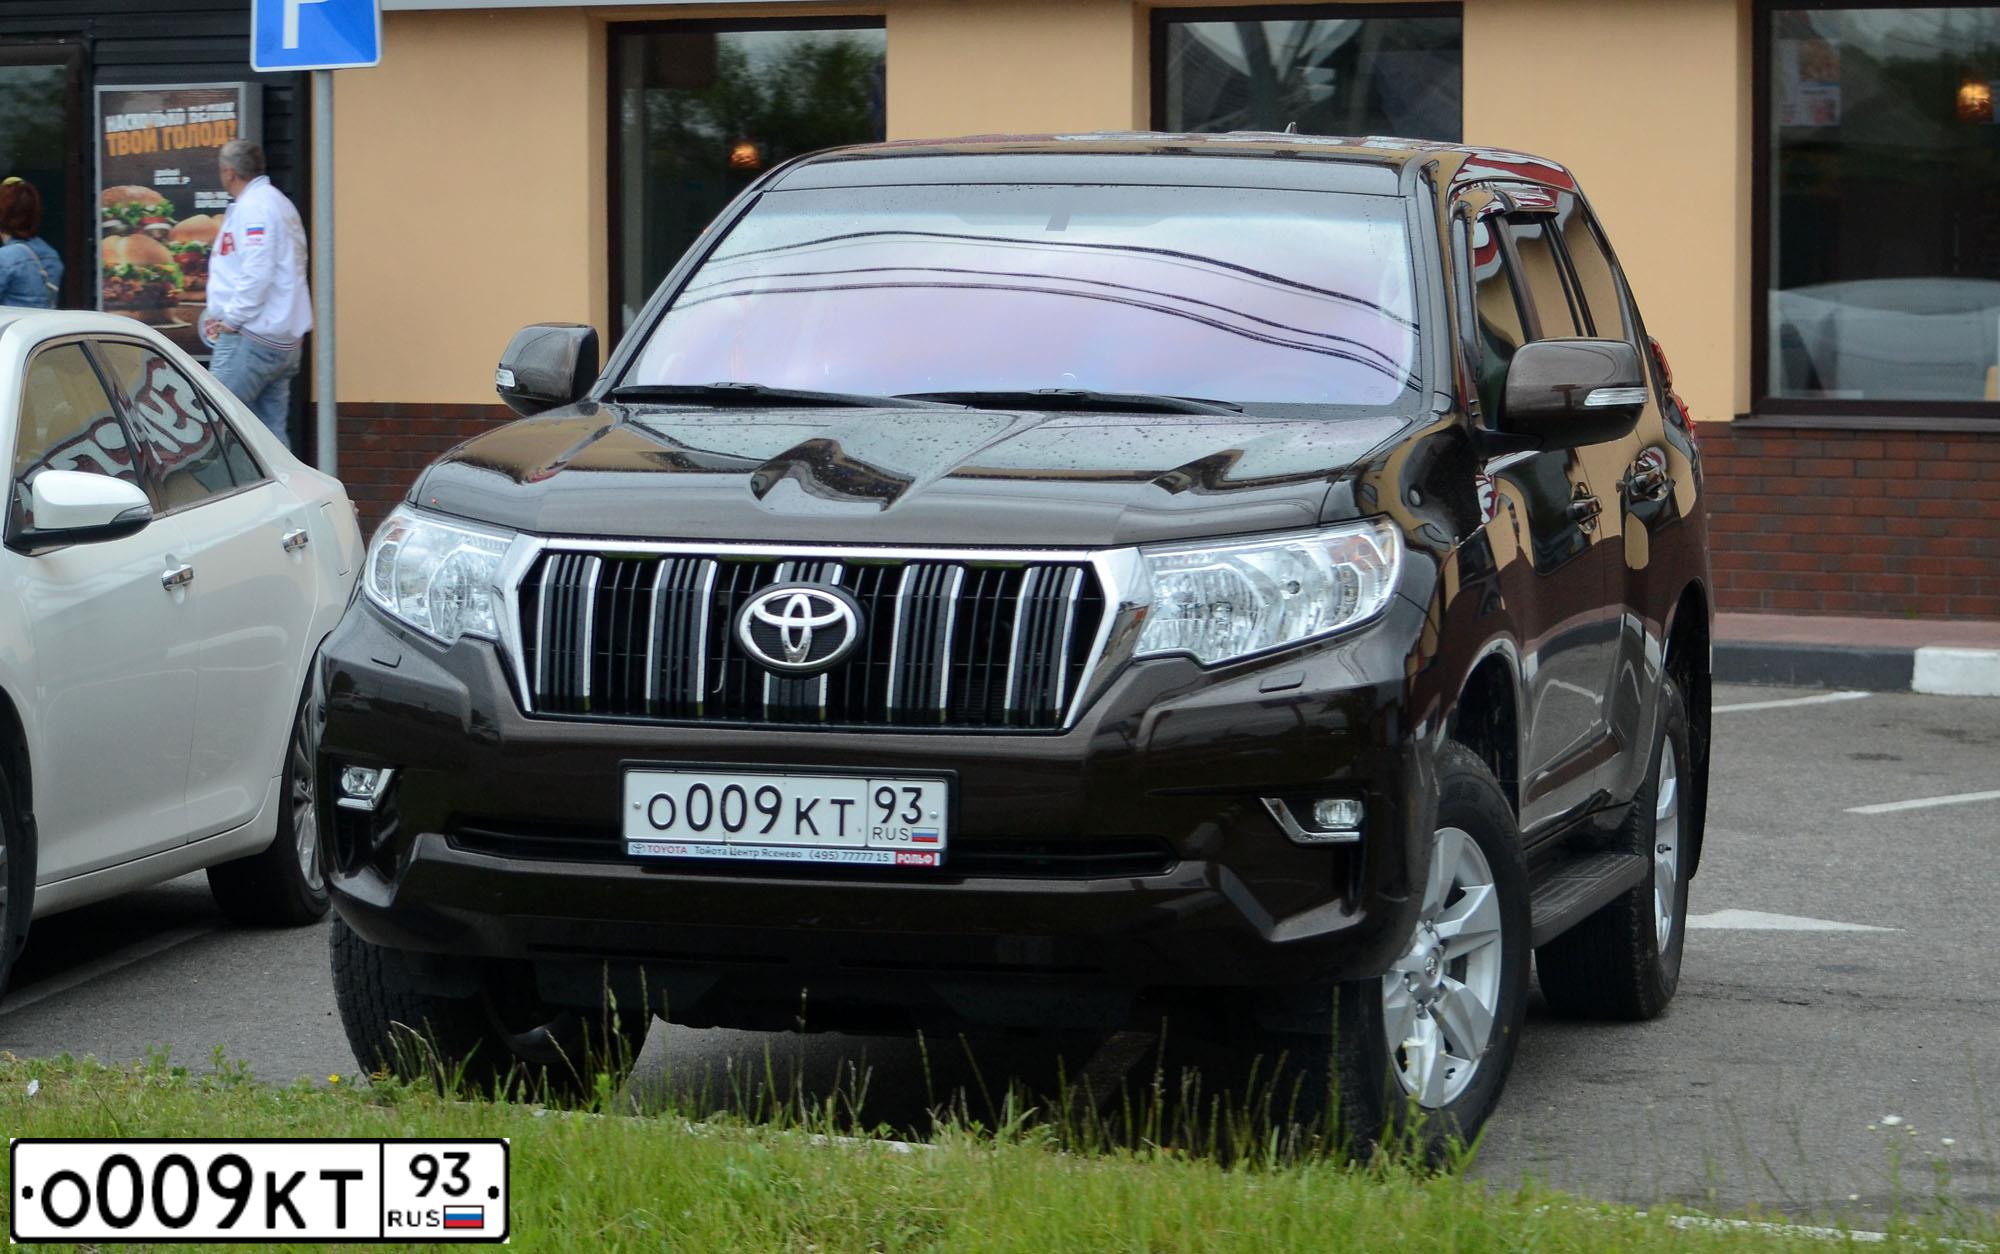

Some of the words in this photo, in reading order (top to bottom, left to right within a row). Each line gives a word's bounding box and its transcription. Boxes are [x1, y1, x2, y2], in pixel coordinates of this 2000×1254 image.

[105, 122, 159, 157] ТВОЙ
[874, 785, 923, 825] 93
[872, 827, 909, 841] RUS
[647, 845, 688, 855] TOYOTA
[694, 846, 727, 856] Тойота
[729, 847, 759, 858] Центр
[809, 850, 839, 860] (495)
